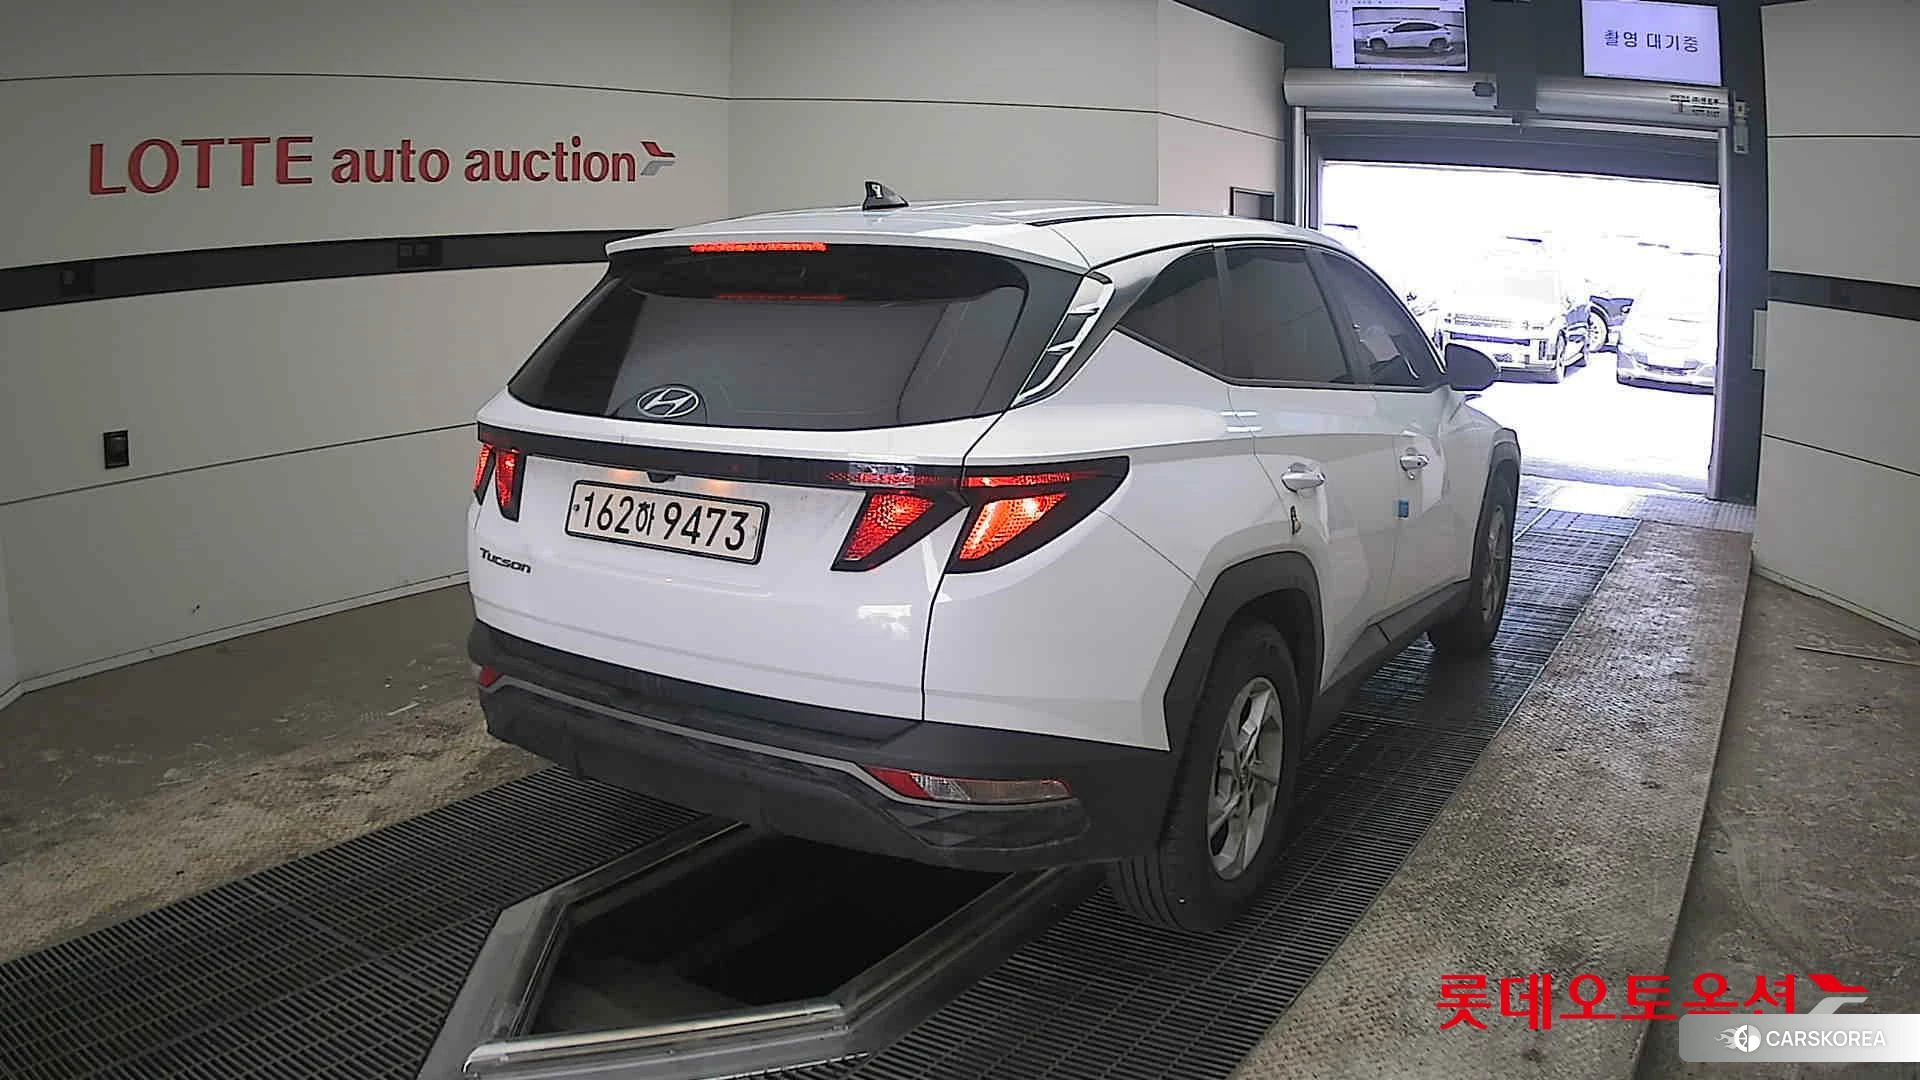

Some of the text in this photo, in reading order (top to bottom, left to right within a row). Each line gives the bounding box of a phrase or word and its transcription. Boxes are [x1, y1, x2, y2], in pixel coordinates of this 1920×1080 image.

[1646, 33, 1699, 53] 대기중
[88, 135, 637, 195] LOTTE auto auction
[583, 490, 750, 551] 162하 9473
[479, 547, 532, 573] Tucson
